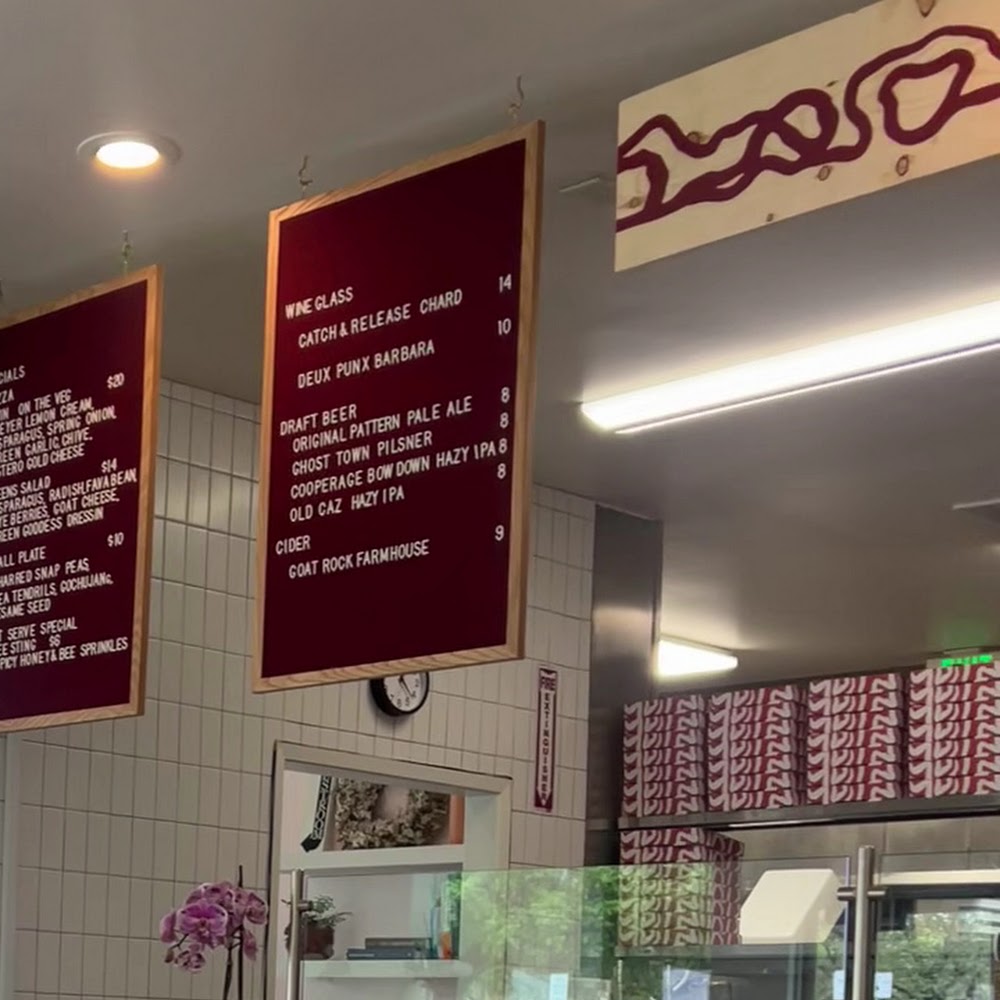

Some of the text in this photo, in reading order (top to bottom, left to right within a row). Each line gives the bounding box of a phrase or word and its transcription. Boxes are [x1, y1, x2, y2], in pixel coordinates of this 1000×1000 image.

[285, 286, 354, 320] WINE GLASS
[298, 274, 512, 349] CATCH & RELEASE CHARD 14
[297, 318, 511, 389] DEUX PUNX BARBARA 10
[18, 400, 31, 416] ON
[34, 394, 52, 411] THE
[25, 407, 56, 428] LEMON
[280, 404, 358, 436] DRAFT BEER
[292, 387, 510, 453] ORIGINAL PATTERN PALE ALE 8
[50, 443, 85, 464] CHEESE
[291, 412, 509, 477] GHOST TOWN PILSNER 8
[20, 475, 51, 494] SALAD
[101, 457, 117, 473] $14
[290, 438, 508, 500] COOPERAGE BOW DOWN HAZY IPA 8
[53, 497, 79, 515] GOAT
[289, 463, 507, 523] OLD CAZ HAZY IPA 8
[18, 545, 47, 565] PLATE
[107, 532, 124, 548] $10
[275, 534, 312, 556] CIDER
[288, 525, 505, 580] GOAT ROCK FARMHOUSE 9
[34, 563, 61, 581] SNAP
[27, 598, 51, 615] SEED
[7, 623, 36, 640] SERVE
[40, 616, 78, 635] SPECIAL
[10, 638, 37, 655] STING
[20, 649, 51, 667] HONEY
[59, 645, 77, 661] BEE
[80, 636, 129, 657] SPRINKLES
